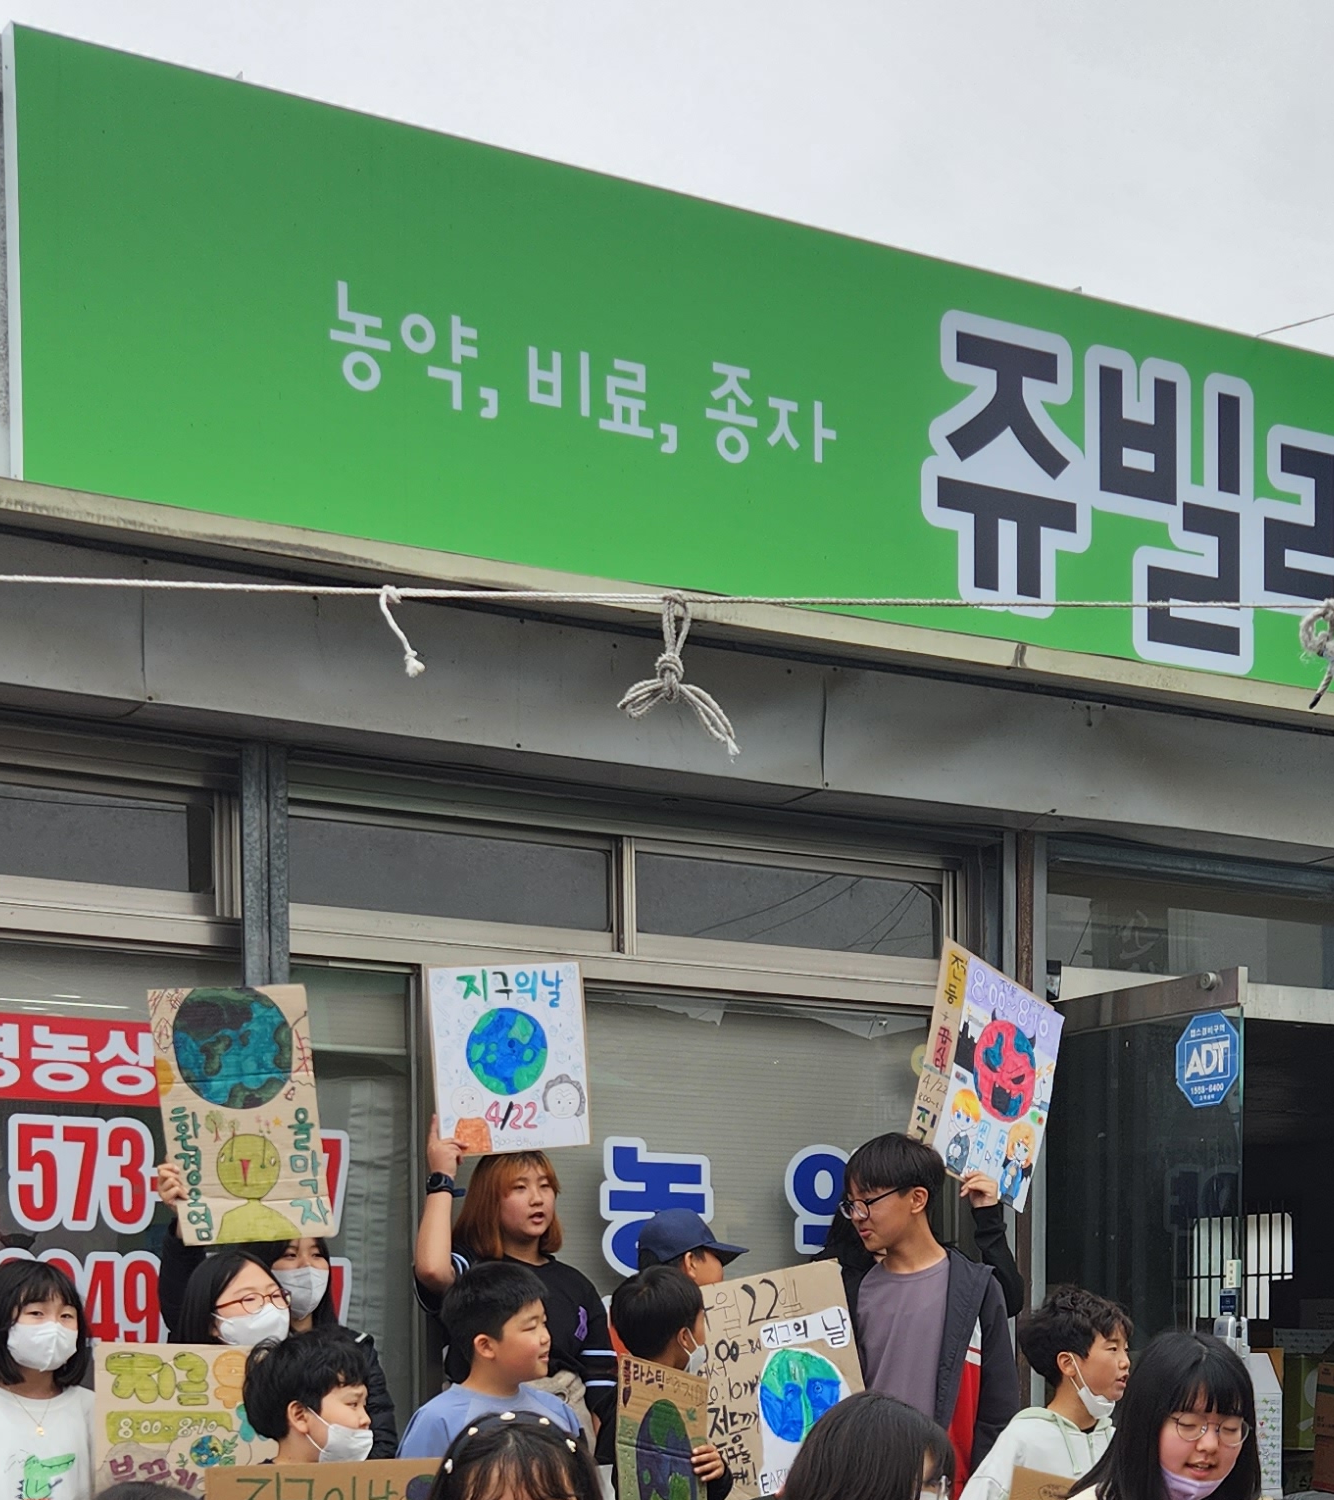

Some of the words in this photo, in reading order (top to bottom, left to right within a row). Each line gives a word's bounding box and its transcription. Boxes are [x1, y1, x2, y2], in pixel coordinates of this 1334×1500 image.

[329, 279, 499, 419] 농약,
[527, 345, 678, 454] 비료,
[705, 361, 838, 463] 종자
[1185, 1040, 1230, 1079] ADT
[484, 1100, 539, 1131] 4/22
